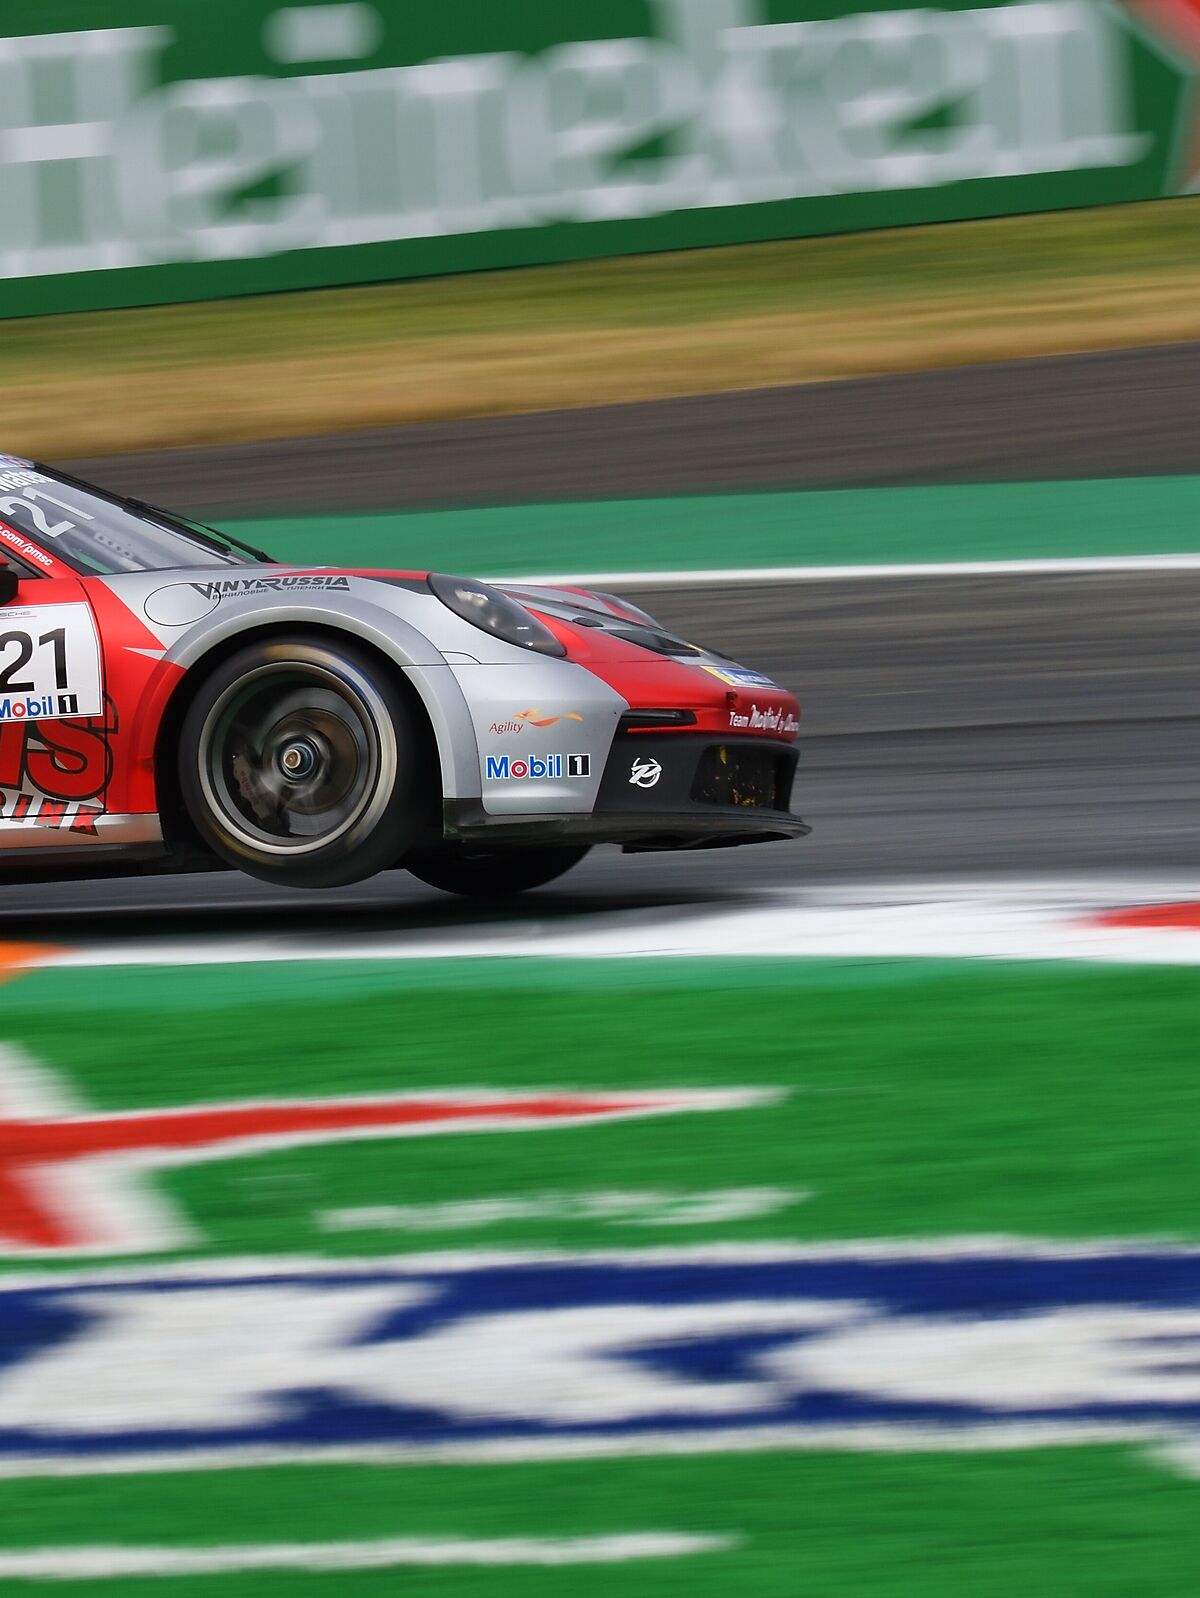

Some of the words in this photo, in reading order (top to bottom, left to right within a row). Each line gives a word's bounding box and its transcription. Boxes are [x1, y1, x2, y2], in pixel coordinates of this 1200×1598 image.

[729, 711, 750, 727] Team
[489, 722, 524, 735] Agility
[486, 754, 562, 779] Mobil
